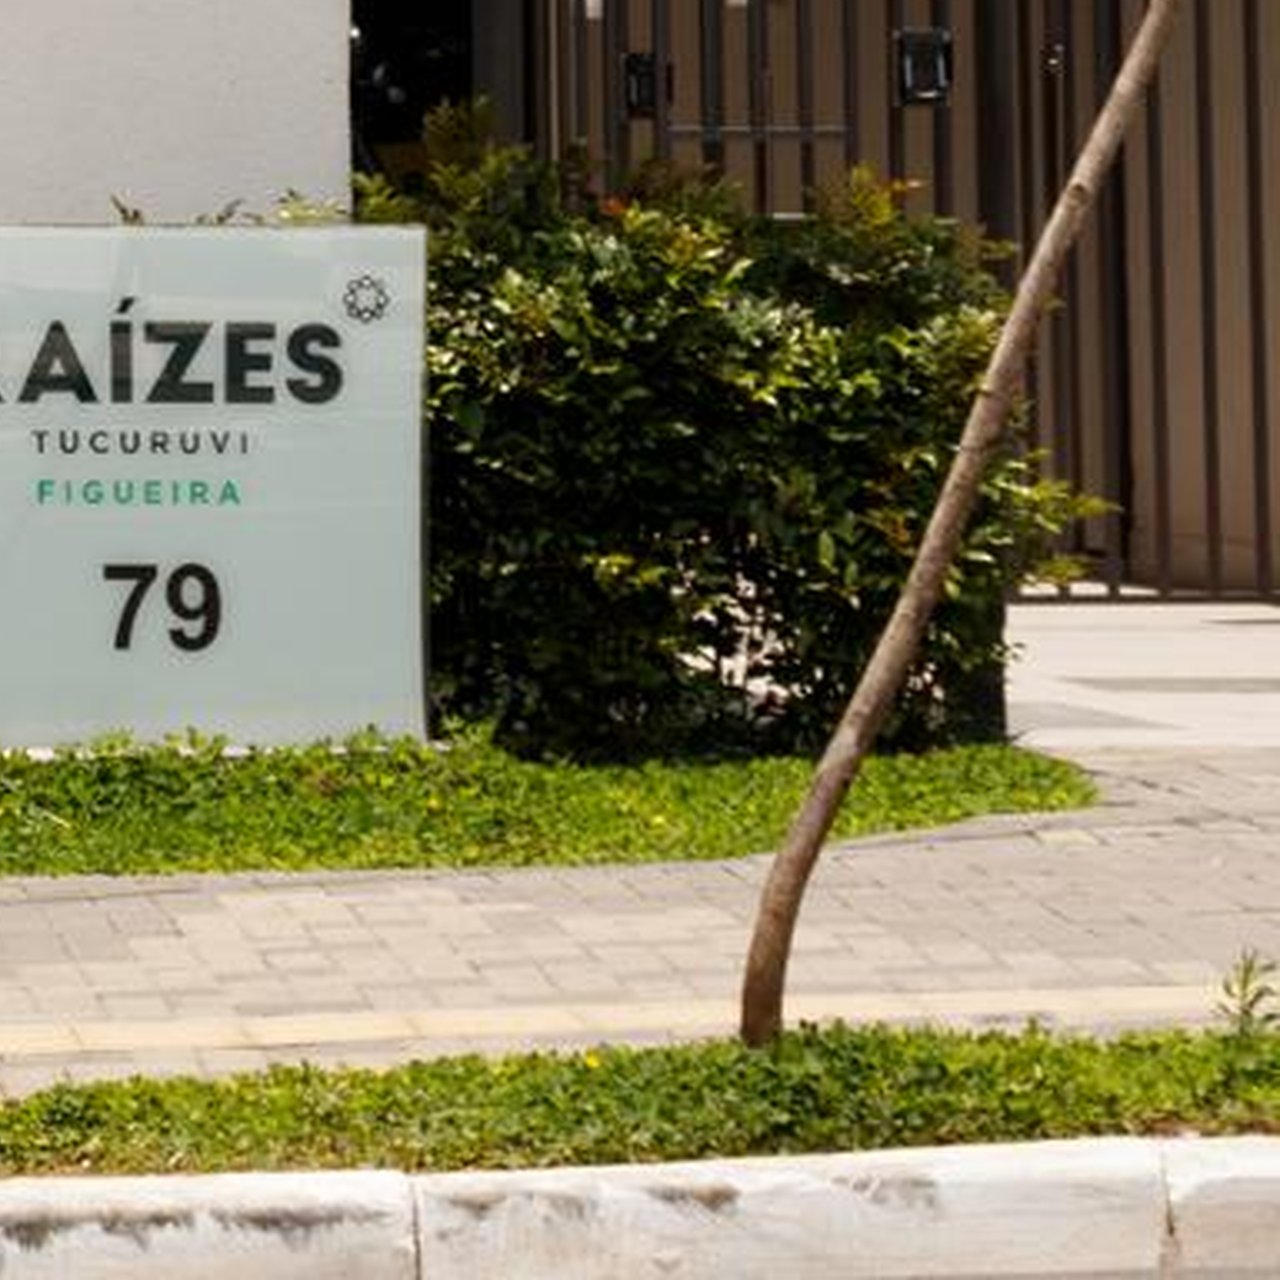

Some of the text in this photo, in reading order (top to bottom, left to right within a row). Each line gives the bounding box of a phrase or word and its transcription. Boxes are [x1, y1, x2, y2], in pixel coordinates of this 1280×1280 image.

[30, 429, 250, 455] TUCURUVI
[35, 479, 242, 505] FIGUEIRA
[102, 562, 223, 652] 79
